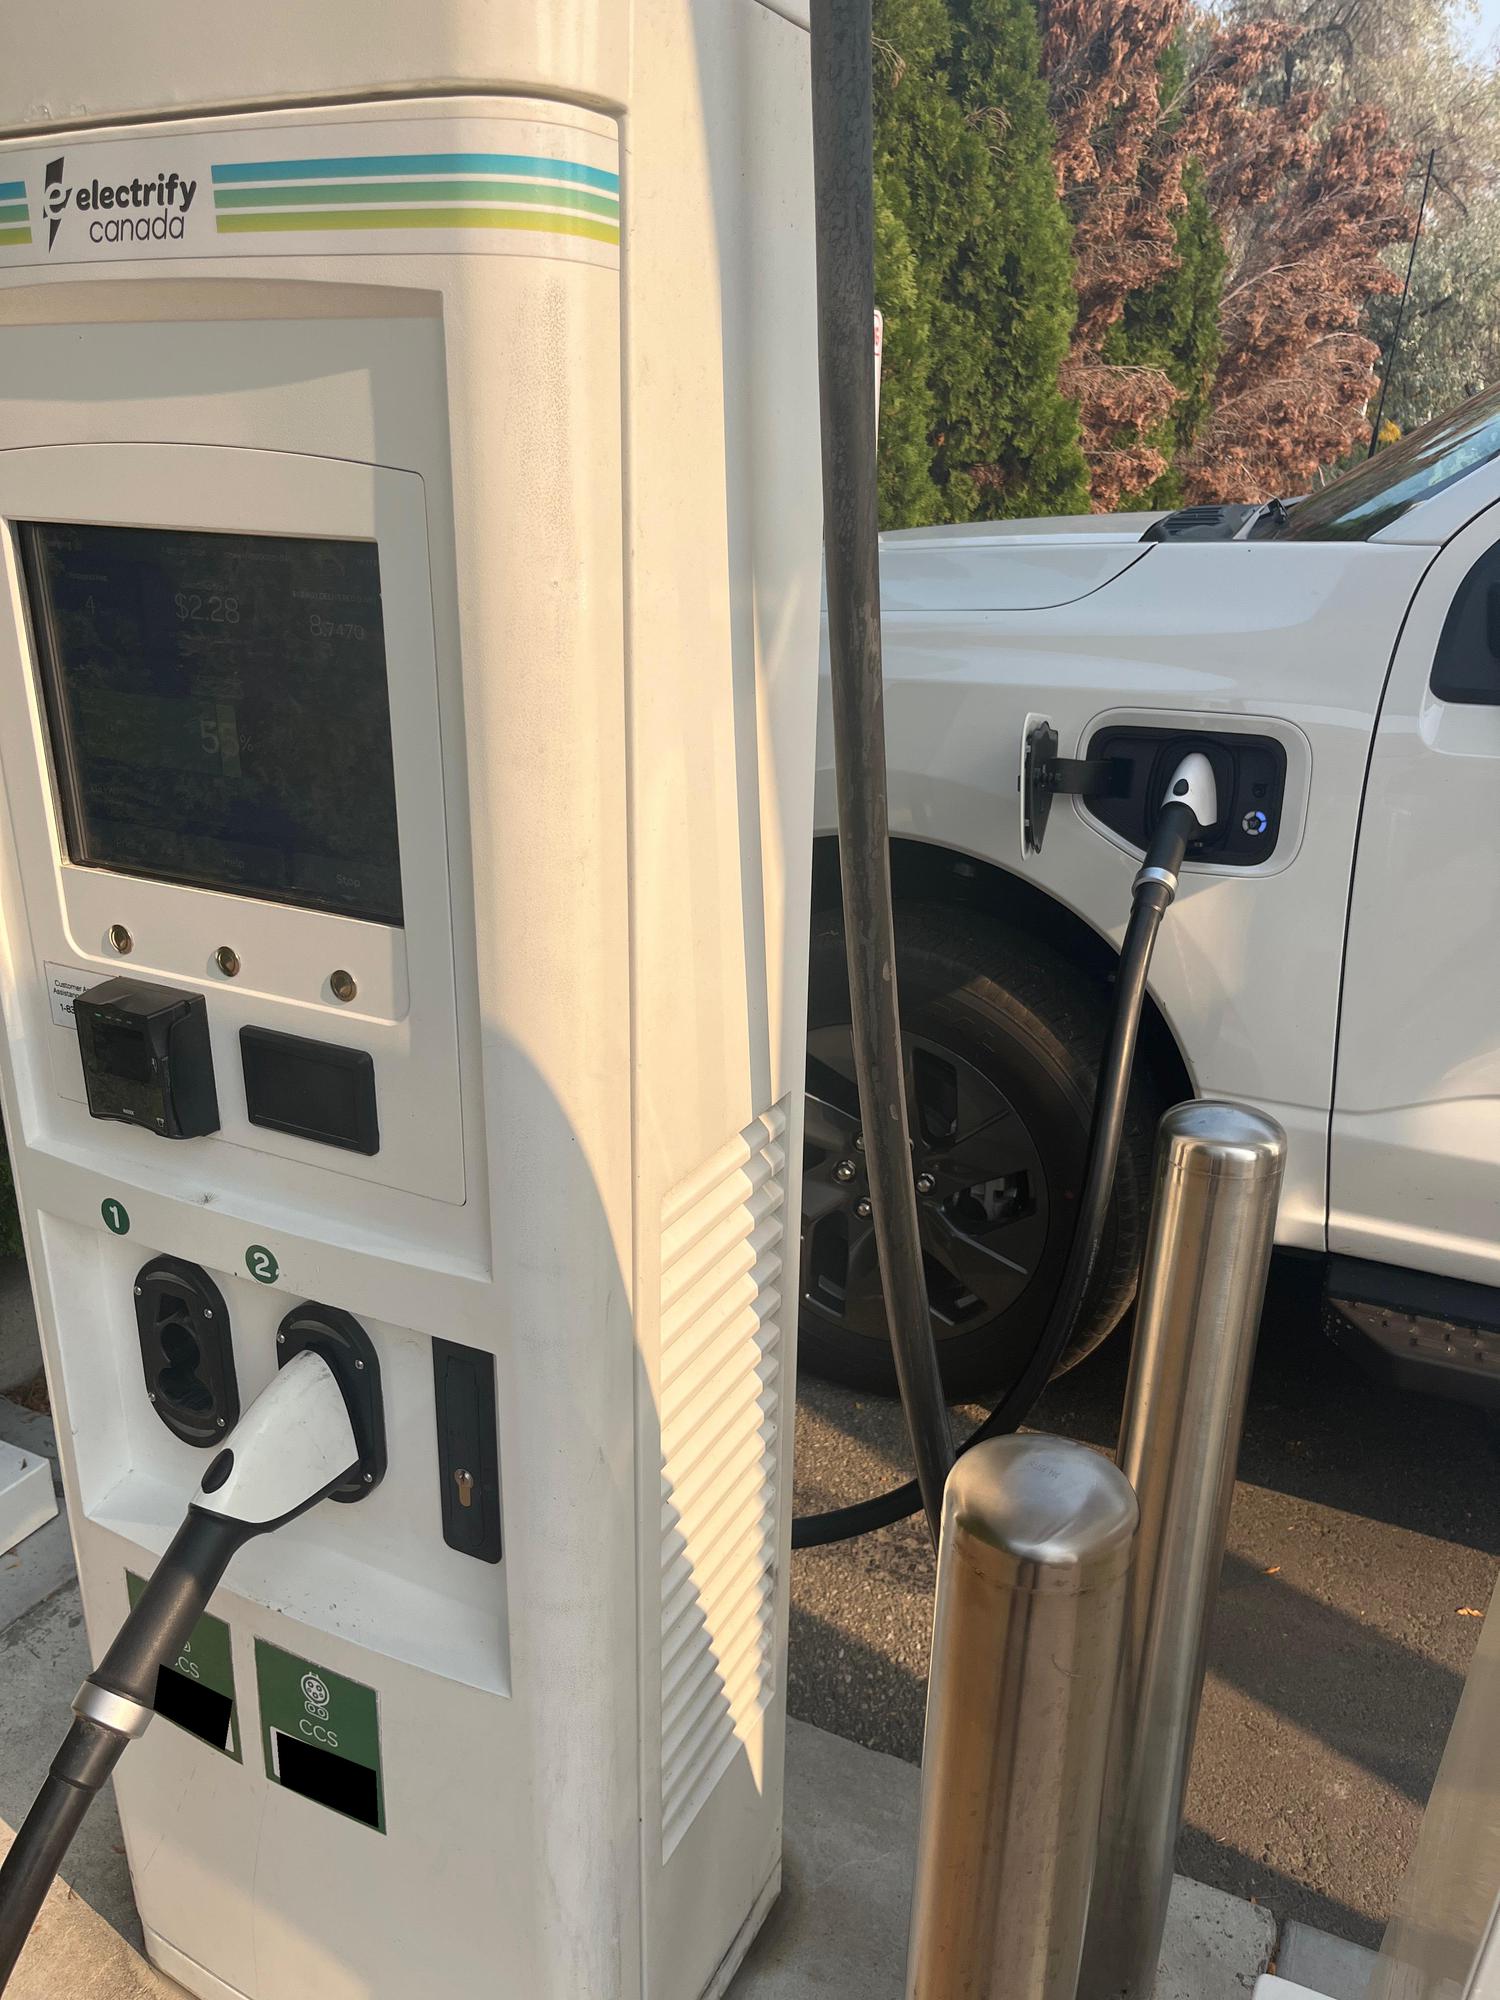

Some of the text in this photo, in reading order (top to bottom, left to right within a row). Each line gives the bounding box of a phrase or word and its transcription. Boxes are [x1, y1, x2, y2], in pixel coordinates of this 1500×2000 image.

[76, 173, 197, 213] electrify
[89, 208, 185, 243] canada
[175, 593, 240, 624] $2.28
[54, 980, 81, 992] Customer
[109, 1206, 120, 1229] 1
[253, 1252, 272, 1277] 2
[175, 1656, 200, 1678] CS
[299, 1719, 339, 1747] CCS
